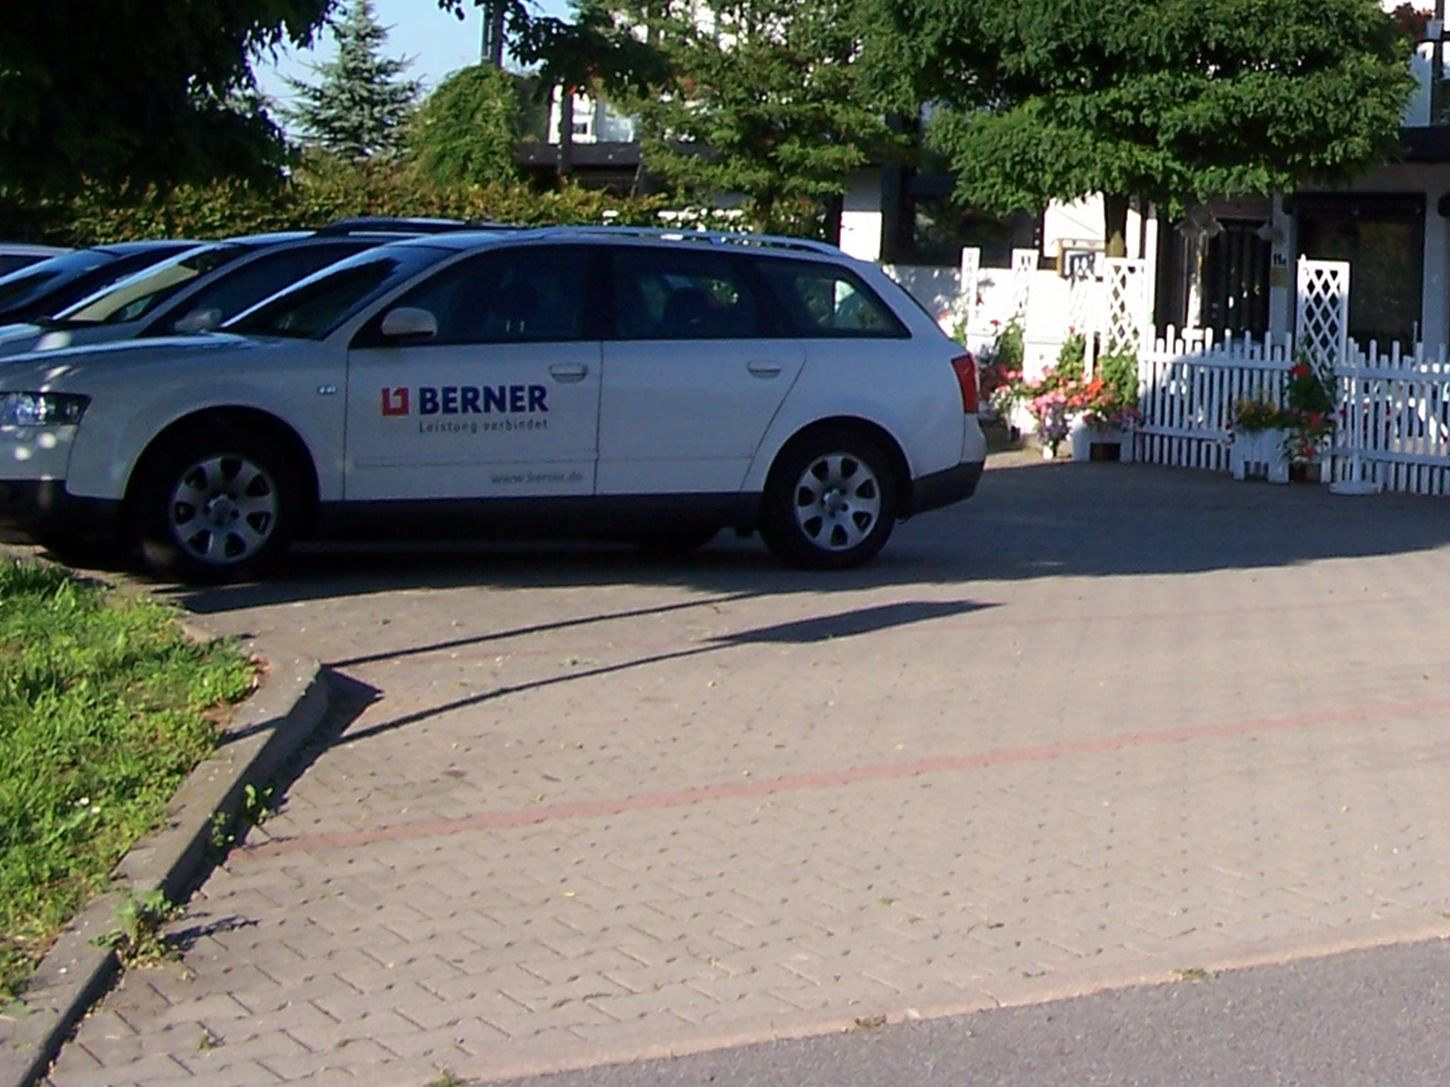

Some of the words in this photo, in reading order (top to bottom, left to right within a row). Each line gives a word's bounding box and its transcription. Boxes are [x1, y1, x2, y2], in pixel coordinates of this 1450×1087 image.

[419, 385, 549, 415] BERNER
[418, 420, 478, 435] Leistung
[483, 418, 549, 432] verbindet
